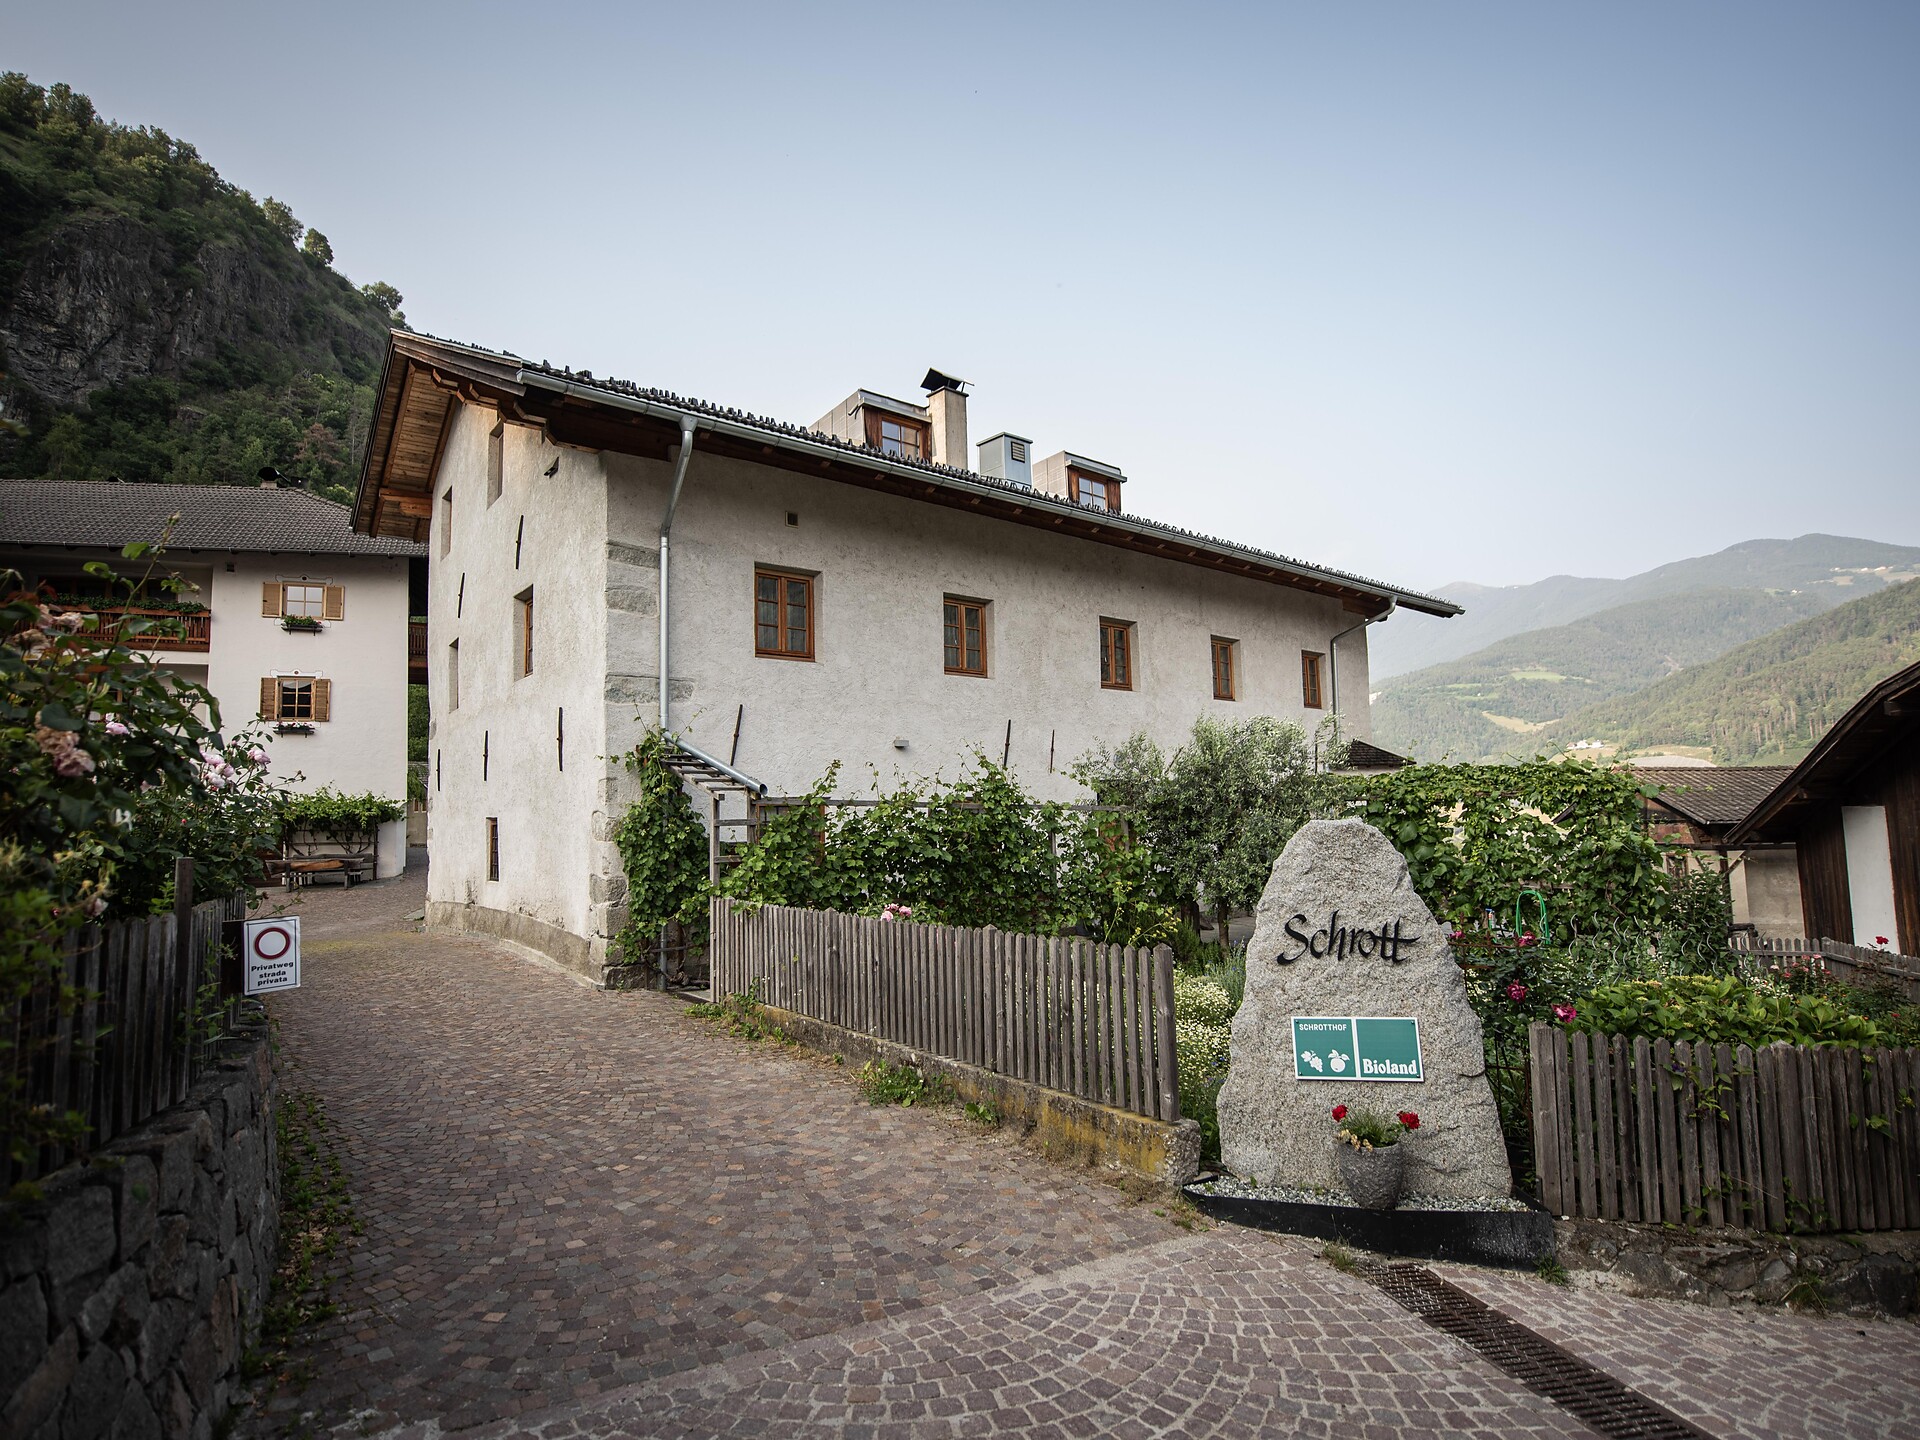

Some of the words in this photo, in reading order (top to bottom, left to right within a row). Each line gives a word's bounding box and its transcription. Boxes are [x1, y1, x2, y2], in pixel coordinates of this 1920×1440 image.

[1277, 909, 1421, 965] Schrott
[251, 961, 294, 972] Privatweg
[259, 970, 286, 979] strada
[257, 976, 288, 987] privata
[1299, 1023, 1347, 1031] SCHROTTHOF
[1362, 1058, 1417, 1075] Bioland
